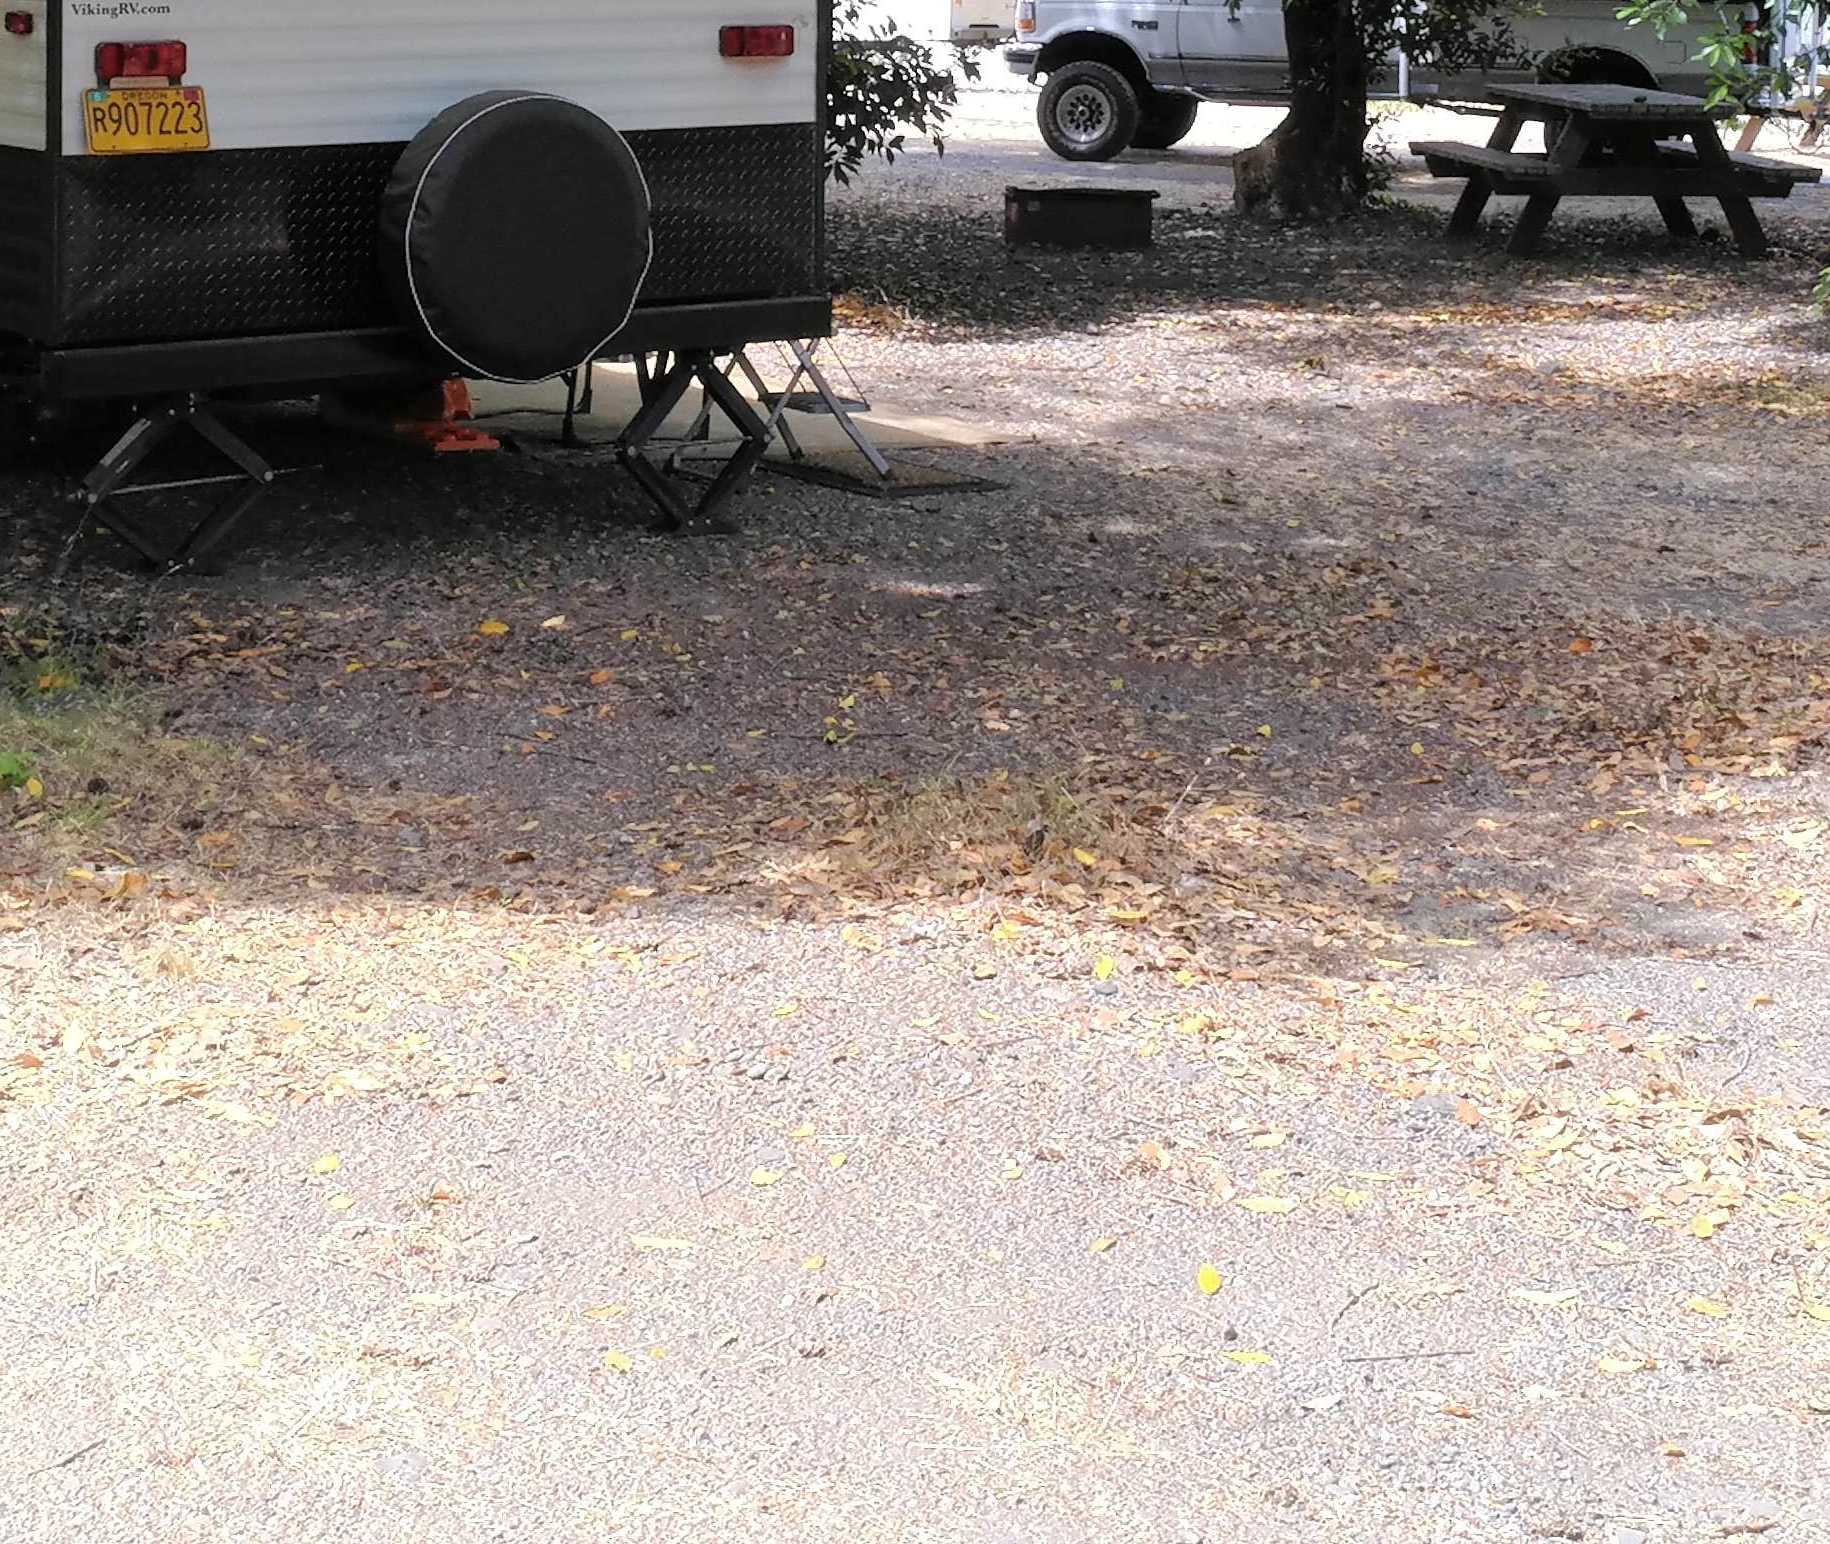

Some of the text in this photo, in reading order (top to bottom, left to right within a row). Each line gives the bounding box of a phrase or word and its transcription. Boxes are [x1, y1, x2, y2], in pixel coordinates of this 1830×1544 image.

[71, 2, 171, 19] VikingRV.com
[122, 91, 168, 101] OREGON
[92, 101, 204, 136] R907223
